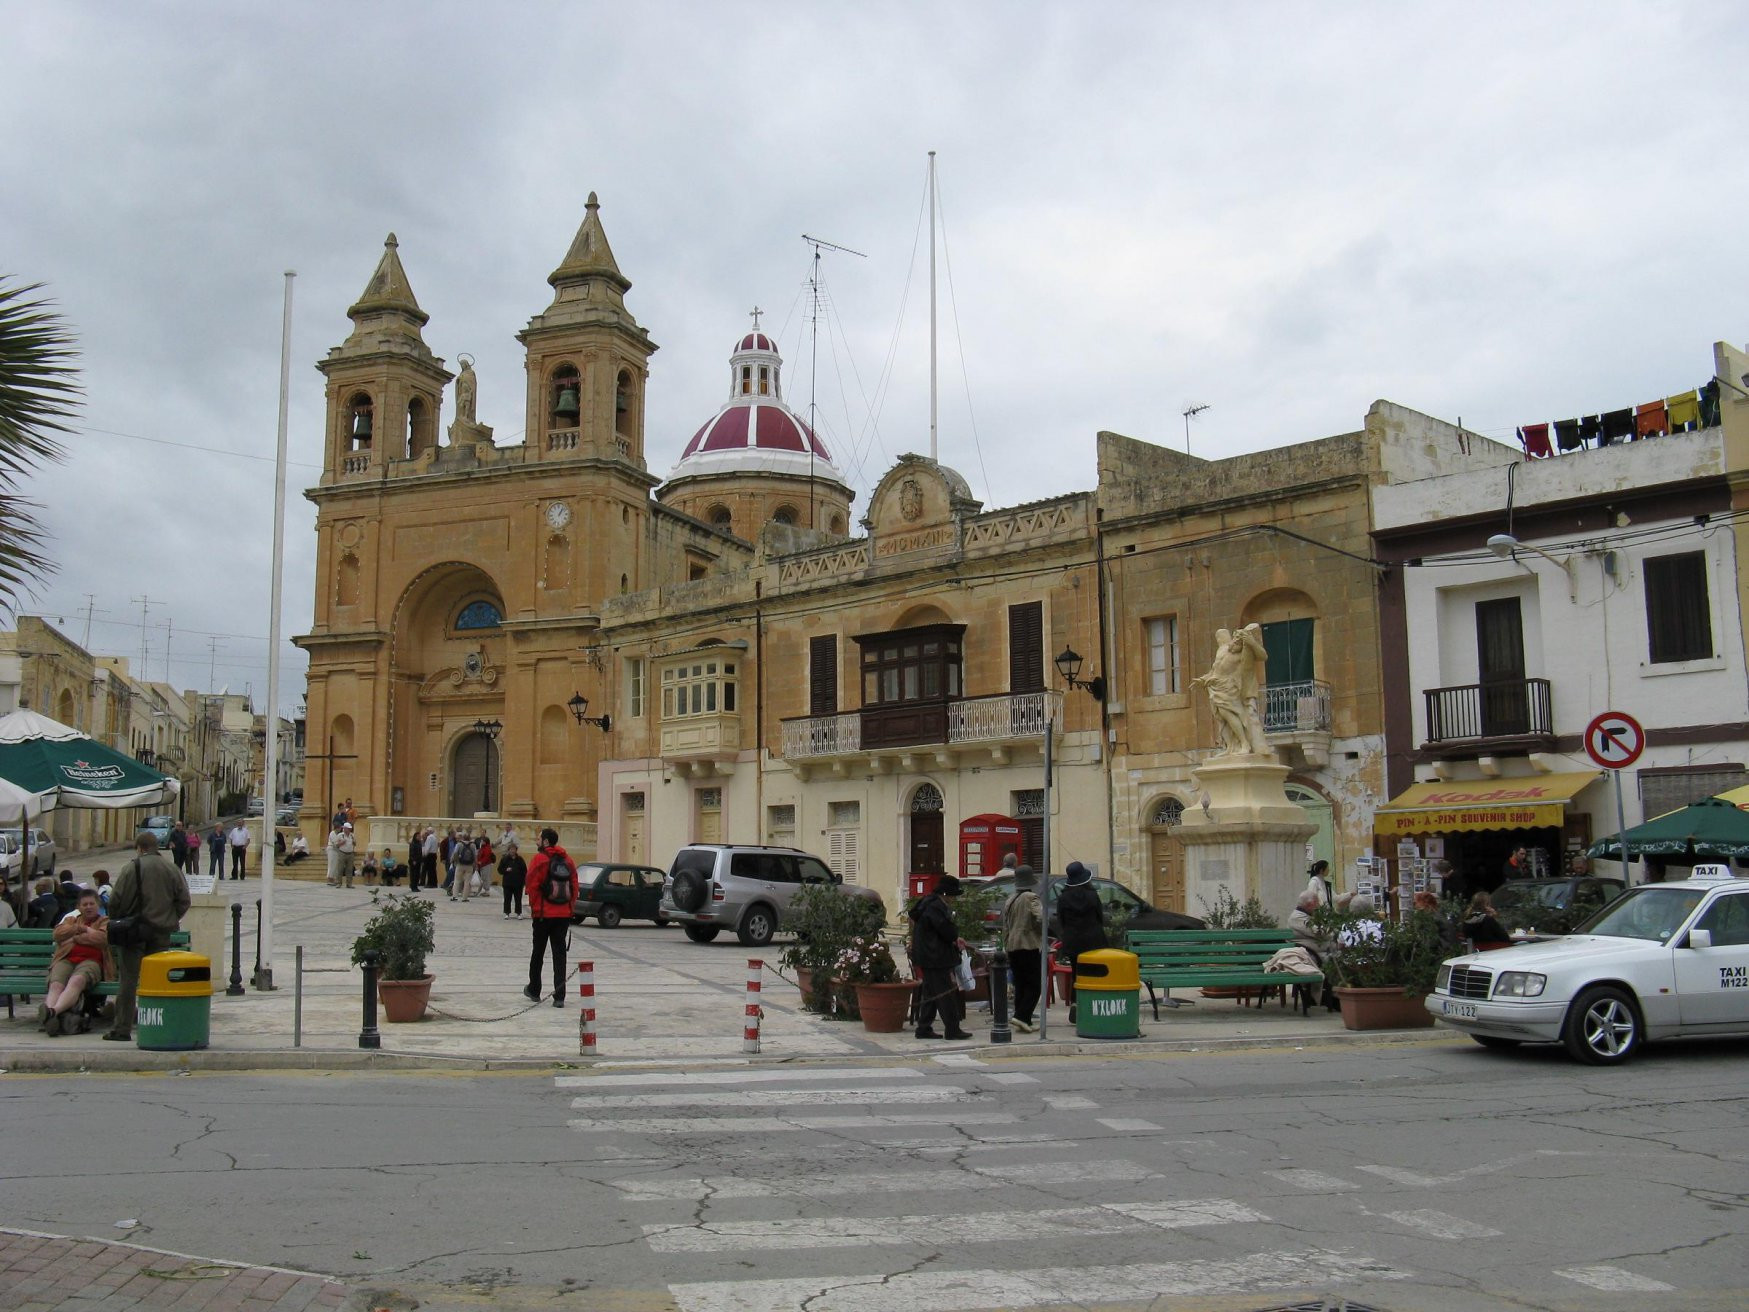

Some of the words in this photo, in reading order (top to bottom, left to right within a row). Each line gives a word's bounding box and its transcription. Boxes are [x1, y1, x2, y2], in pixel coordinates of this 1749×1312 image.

[67, 768, 118, 778] Heineken
[1418, 786, 1551, 805] Kodak
[1396, 818, 1415, 829] PIN
[1461, 812, 1507, 824] SOUVENIR
[1510, 812, 1536, 823] SHOP
[1695, 866, 1718, 876] TAXI
[1720, 966, 1747, 978] TAXI
[1721, 977, 1748, 988] M122
